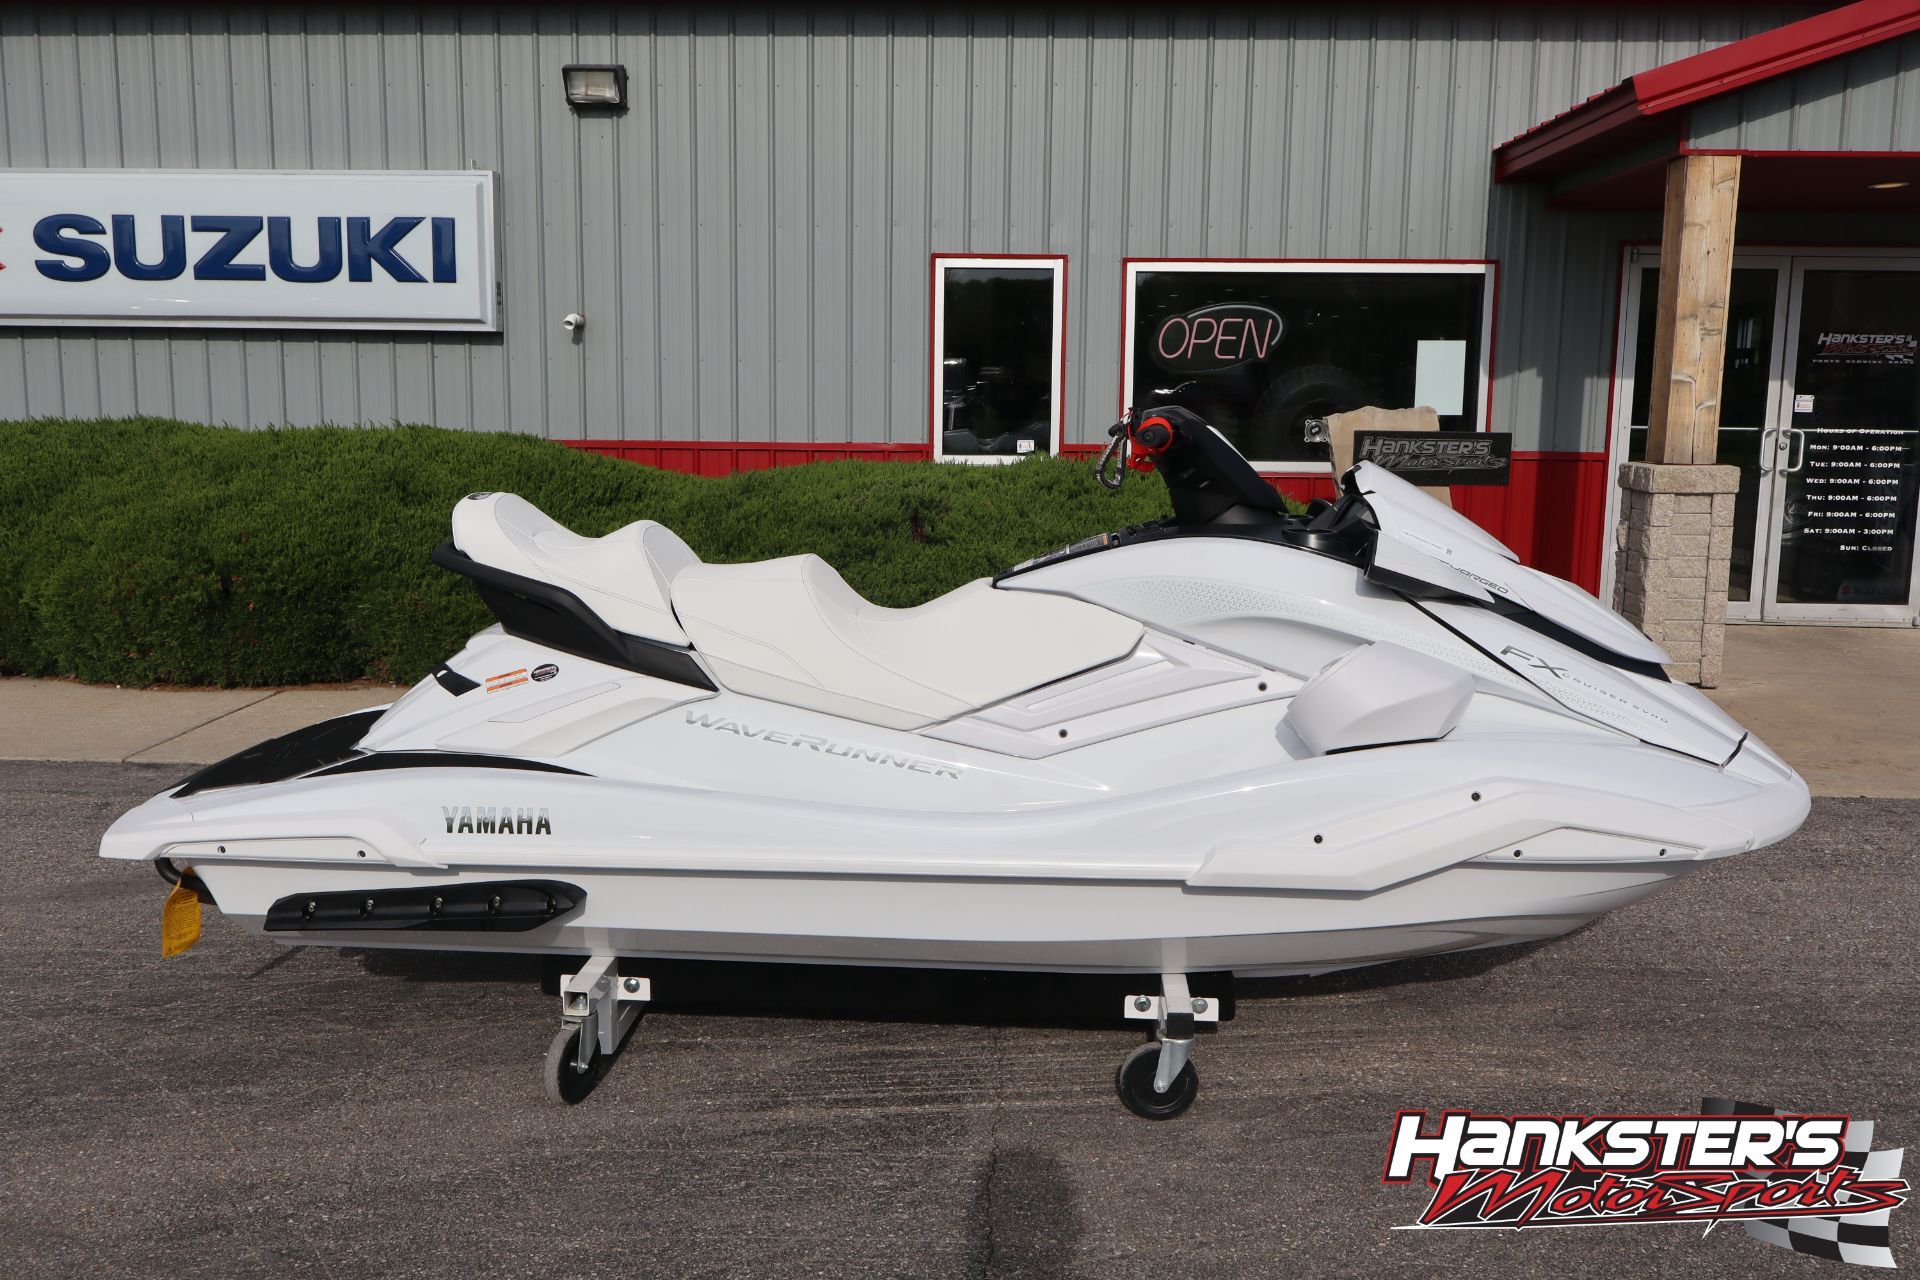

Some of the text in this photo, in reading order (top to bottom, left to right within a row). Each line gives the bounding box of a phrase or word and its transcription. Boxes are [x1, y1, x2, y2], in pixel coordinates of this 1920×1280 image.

[33, 213, 457, 283] SUZUKI
[1158, 317, 1273, 359] OPEN
[1500, 645, 1568, 680] FX
[1562, 673, 1628, 704] CRUISER
[685, 710, 966, 780] WAVERUNNER
[441, 806, 552, 835] YAMAHA
